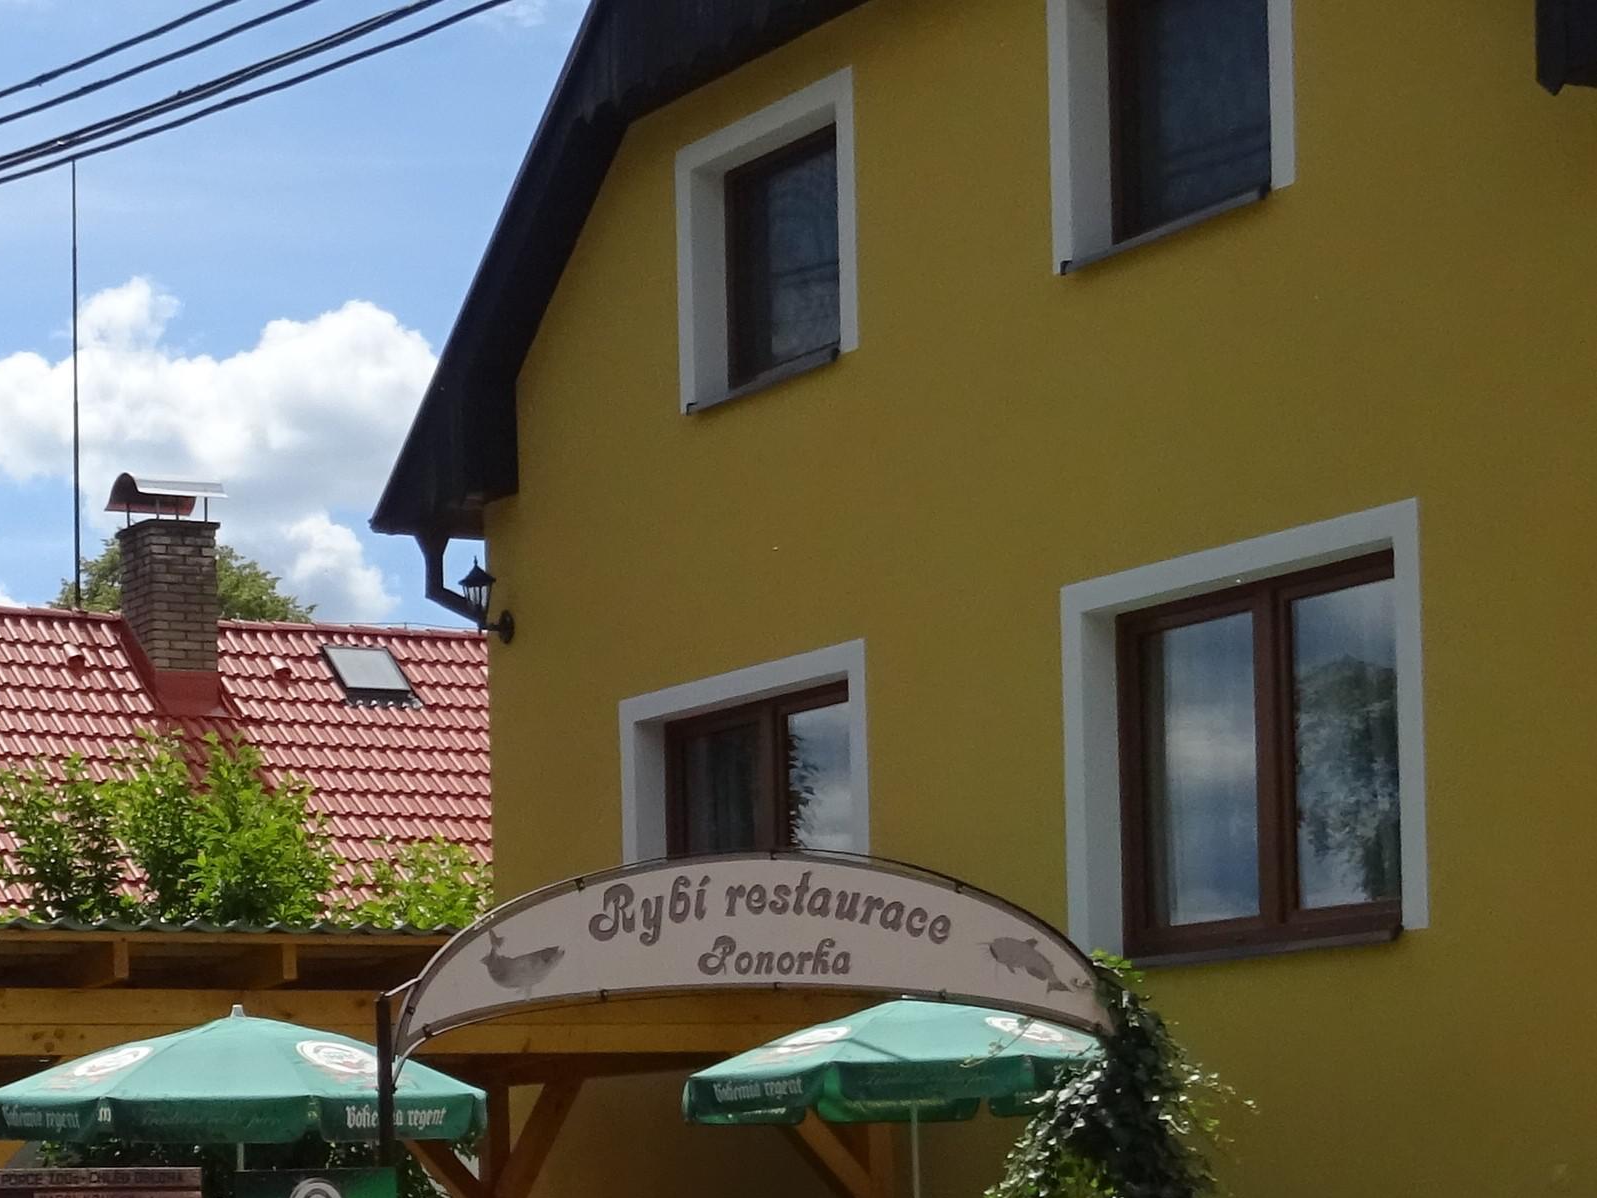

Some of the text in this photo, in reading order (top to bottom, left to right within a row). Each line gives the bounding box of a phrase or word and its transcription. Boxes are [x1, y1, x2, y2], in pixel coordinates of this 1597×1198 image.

[588, 870, 952, 945] Rybí restaurace
[698, 934, 851, 976] Ponorka
[407, 1104, 447, 1131] regent
